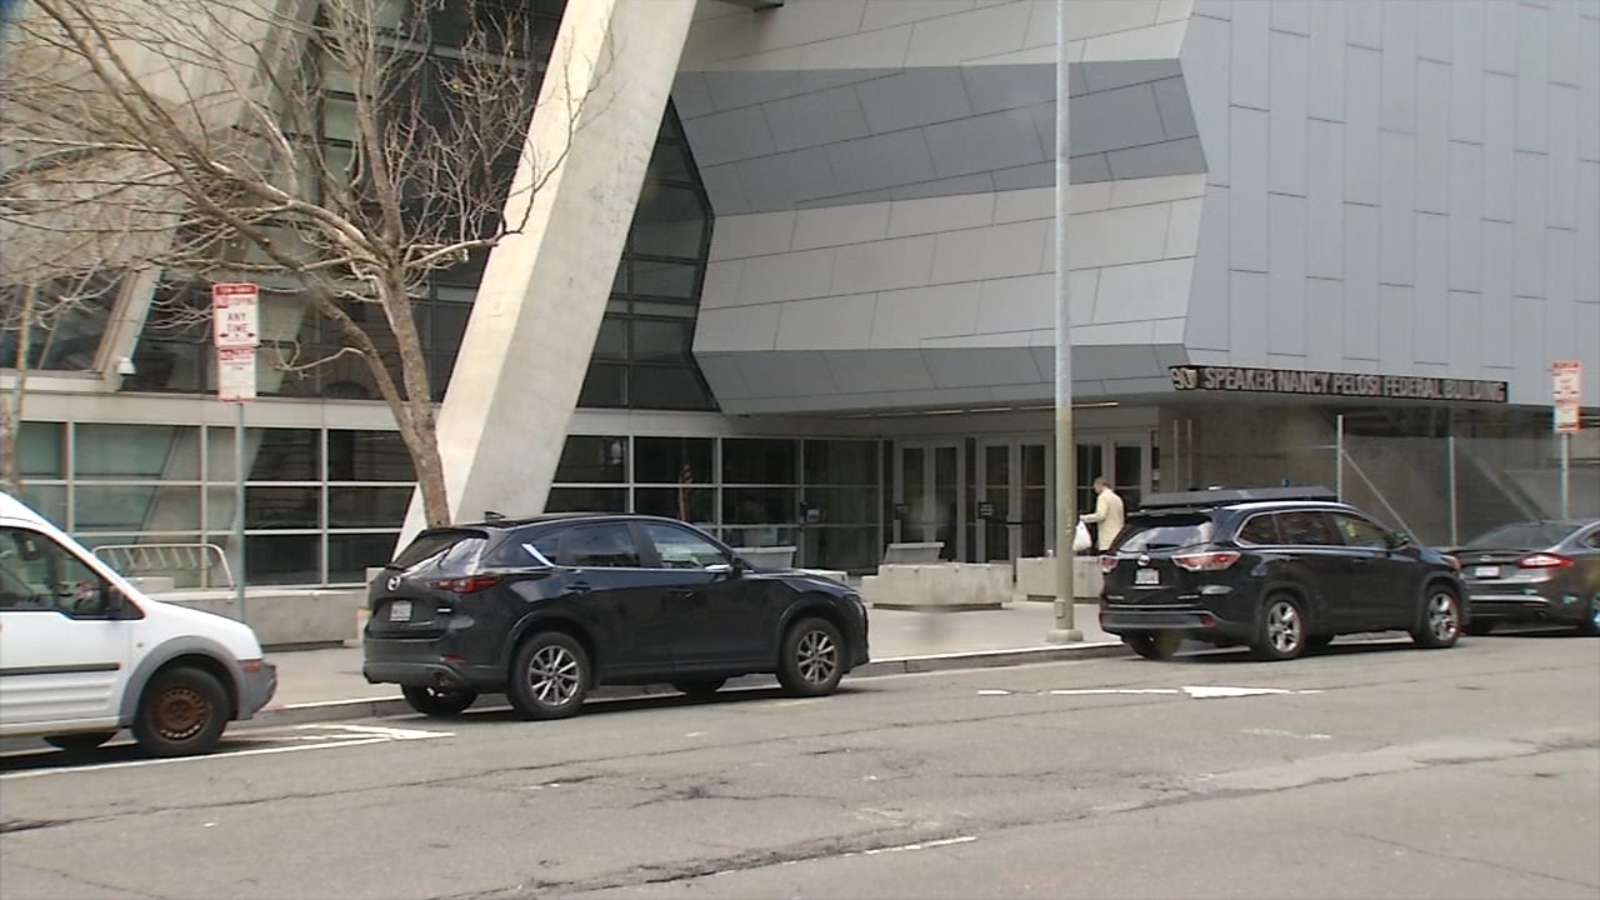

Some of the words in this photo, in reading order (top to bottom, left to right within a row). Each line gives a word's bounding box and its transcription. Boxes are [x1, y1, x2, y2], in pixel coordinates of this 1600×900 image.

[227, 312, 247, 321] ANY
[226, 323, 248, 332] TIME
[1204, 367, 1275, 391] SPEAKER
[1277, 371, 1330, 393] NANCY
[1332, 373, 1381, 396] PELOSI
[1384, 375, 1441, 399] FEDERAL
[1444, 379, 1505, 402] BUILDING
